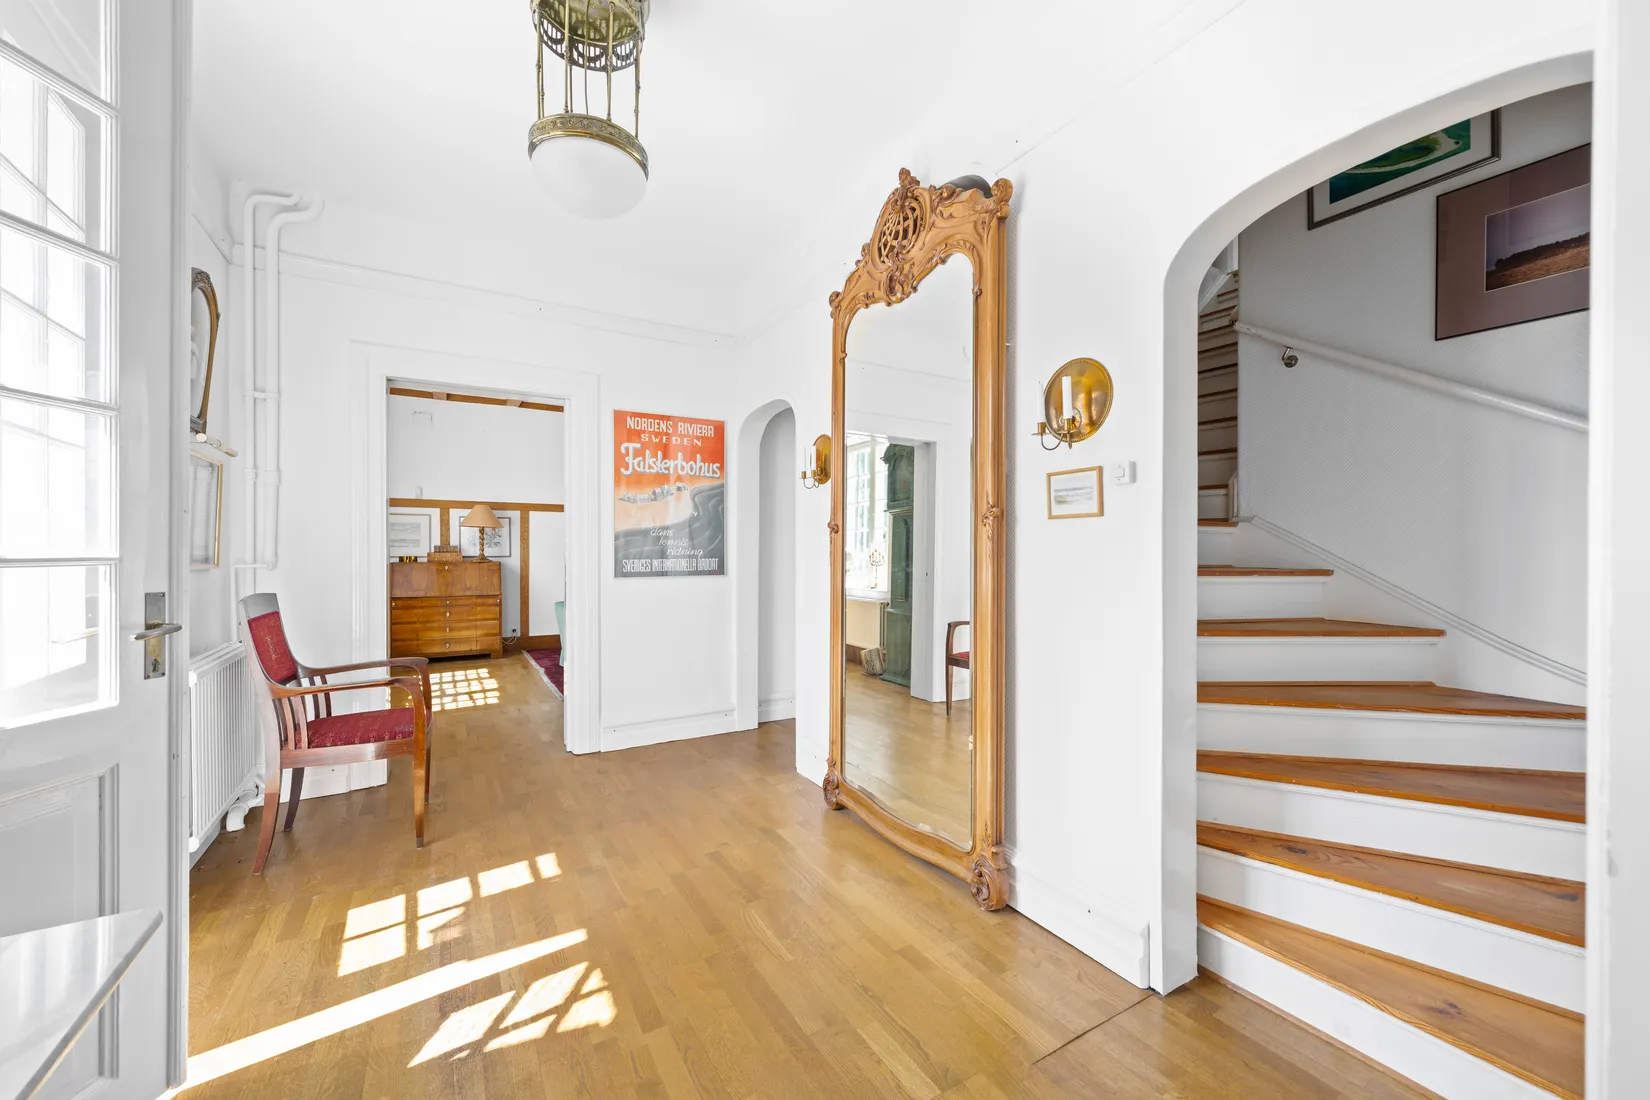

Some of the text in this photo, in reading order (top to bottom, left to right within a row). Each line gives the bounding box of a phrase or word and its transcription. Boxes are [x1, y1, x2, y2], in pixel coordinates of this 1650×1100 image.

[626, 416, 715, 438] NORDENS RIVIERA
[640, 433, 703, 447] SWEDEN
[620, 442, 721, 479] Falsterbohus
[650, 526, 675, 537] dans
[666, 547, 703, 559] ridning
[622, 558, 651, 573] SVERIGES
